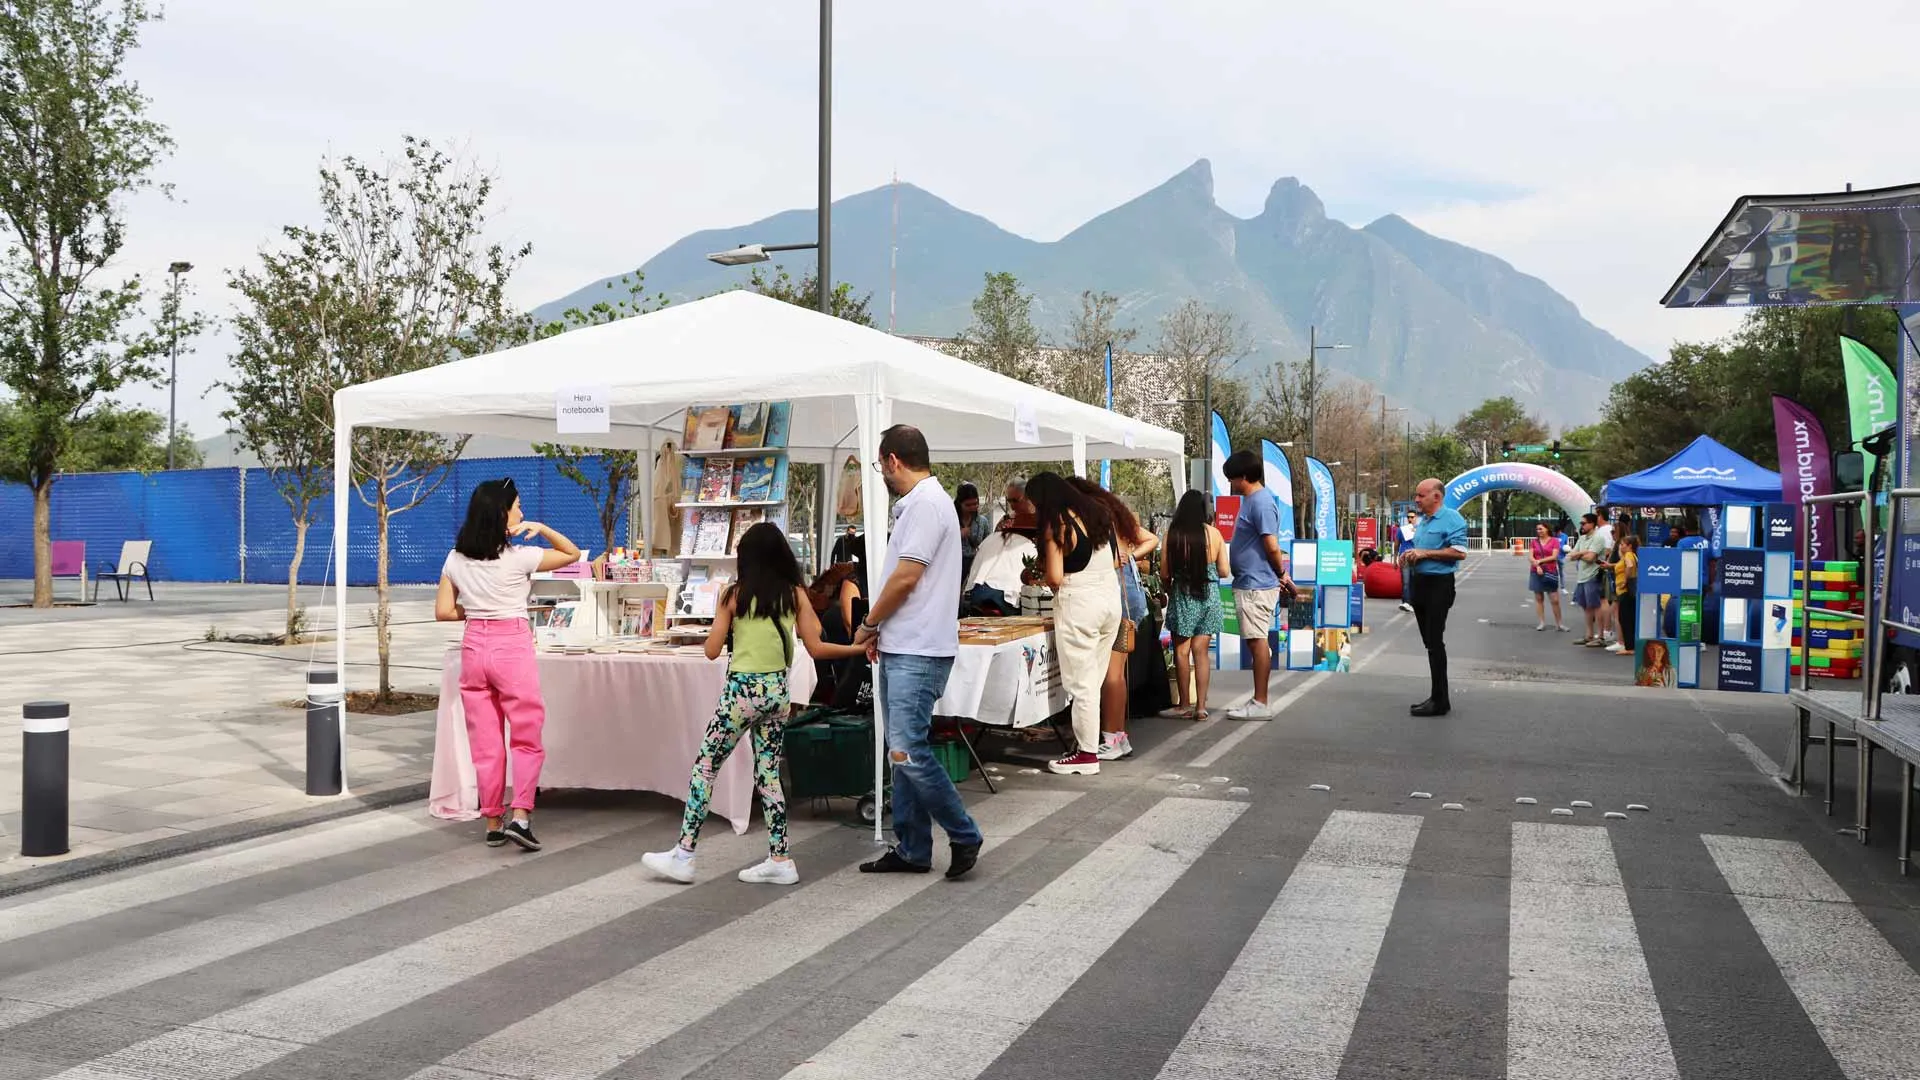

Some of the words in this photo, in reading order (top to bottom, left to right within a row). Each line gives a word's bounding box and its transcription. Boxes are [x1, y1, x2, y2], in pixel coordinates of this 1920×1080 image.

[1452, 478, 1479, 500] ¡Nos
[1481, 472, 1524, 483] vemos
[1528, 476, 1573, 501] pronto!
[1725, 578, 1754, 586] programa
[1722, 656, 1752, 664] beneficios
